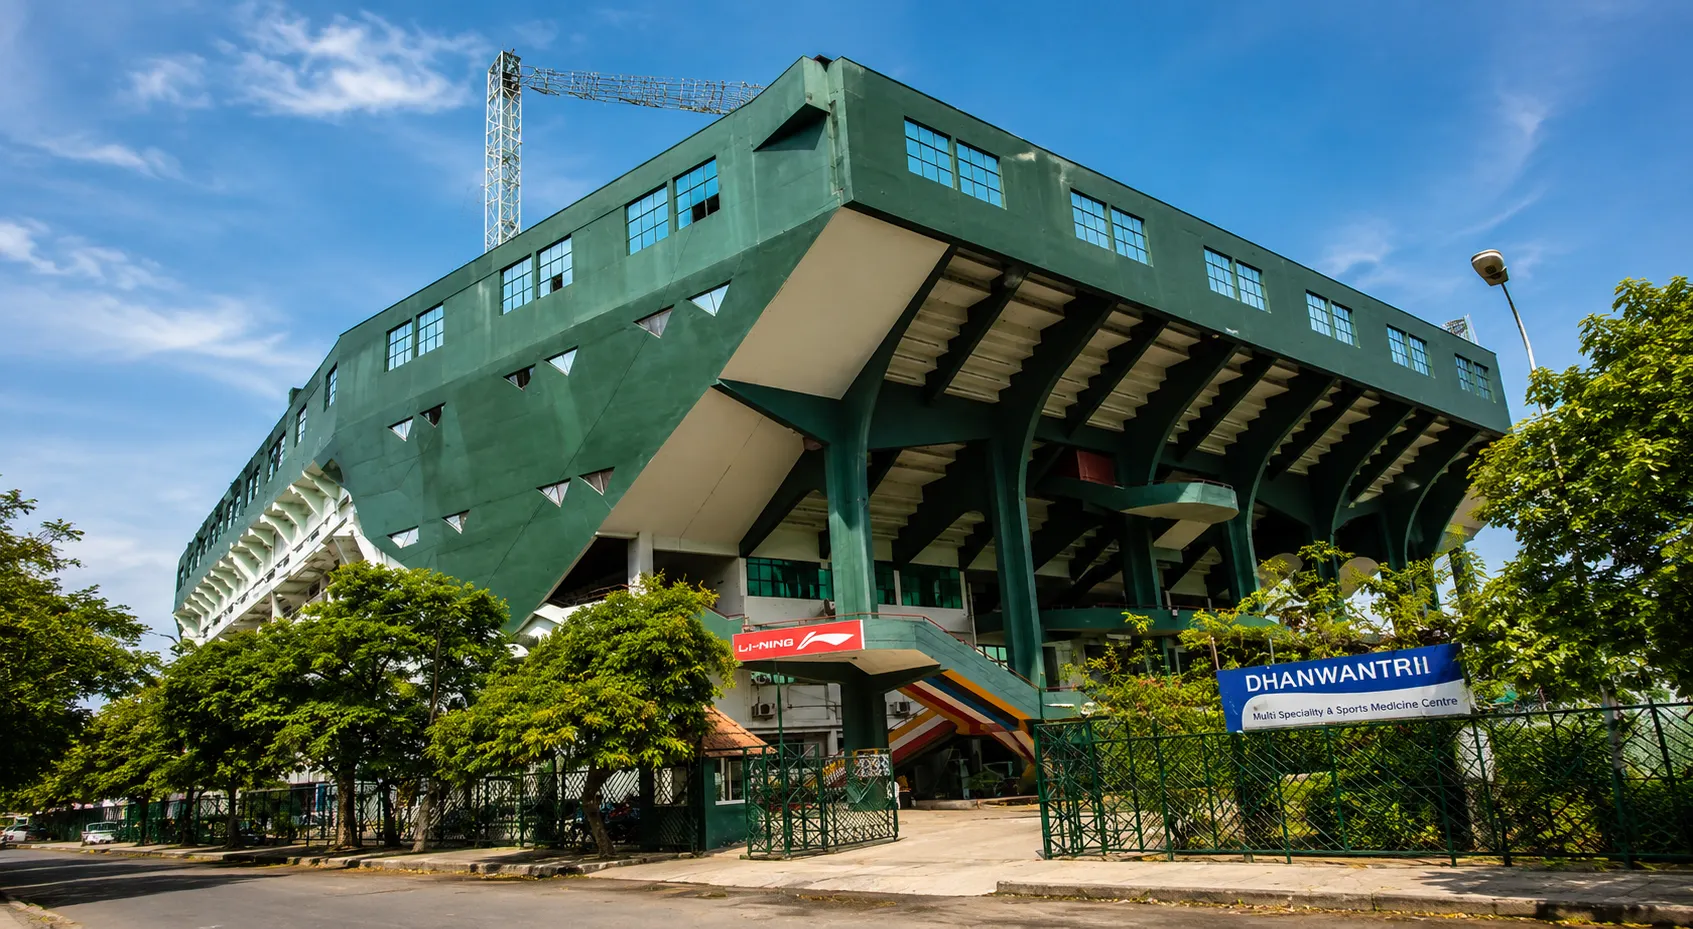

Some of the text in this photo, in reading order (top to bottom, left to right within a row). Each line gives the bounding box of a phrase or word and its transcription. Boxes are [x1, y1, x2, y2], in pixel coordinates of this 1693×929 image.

[738, 638, 794, 653] LI-NING
[1253, 697, 1458, 721] Multi Speciality & Sports Medicine Centre
